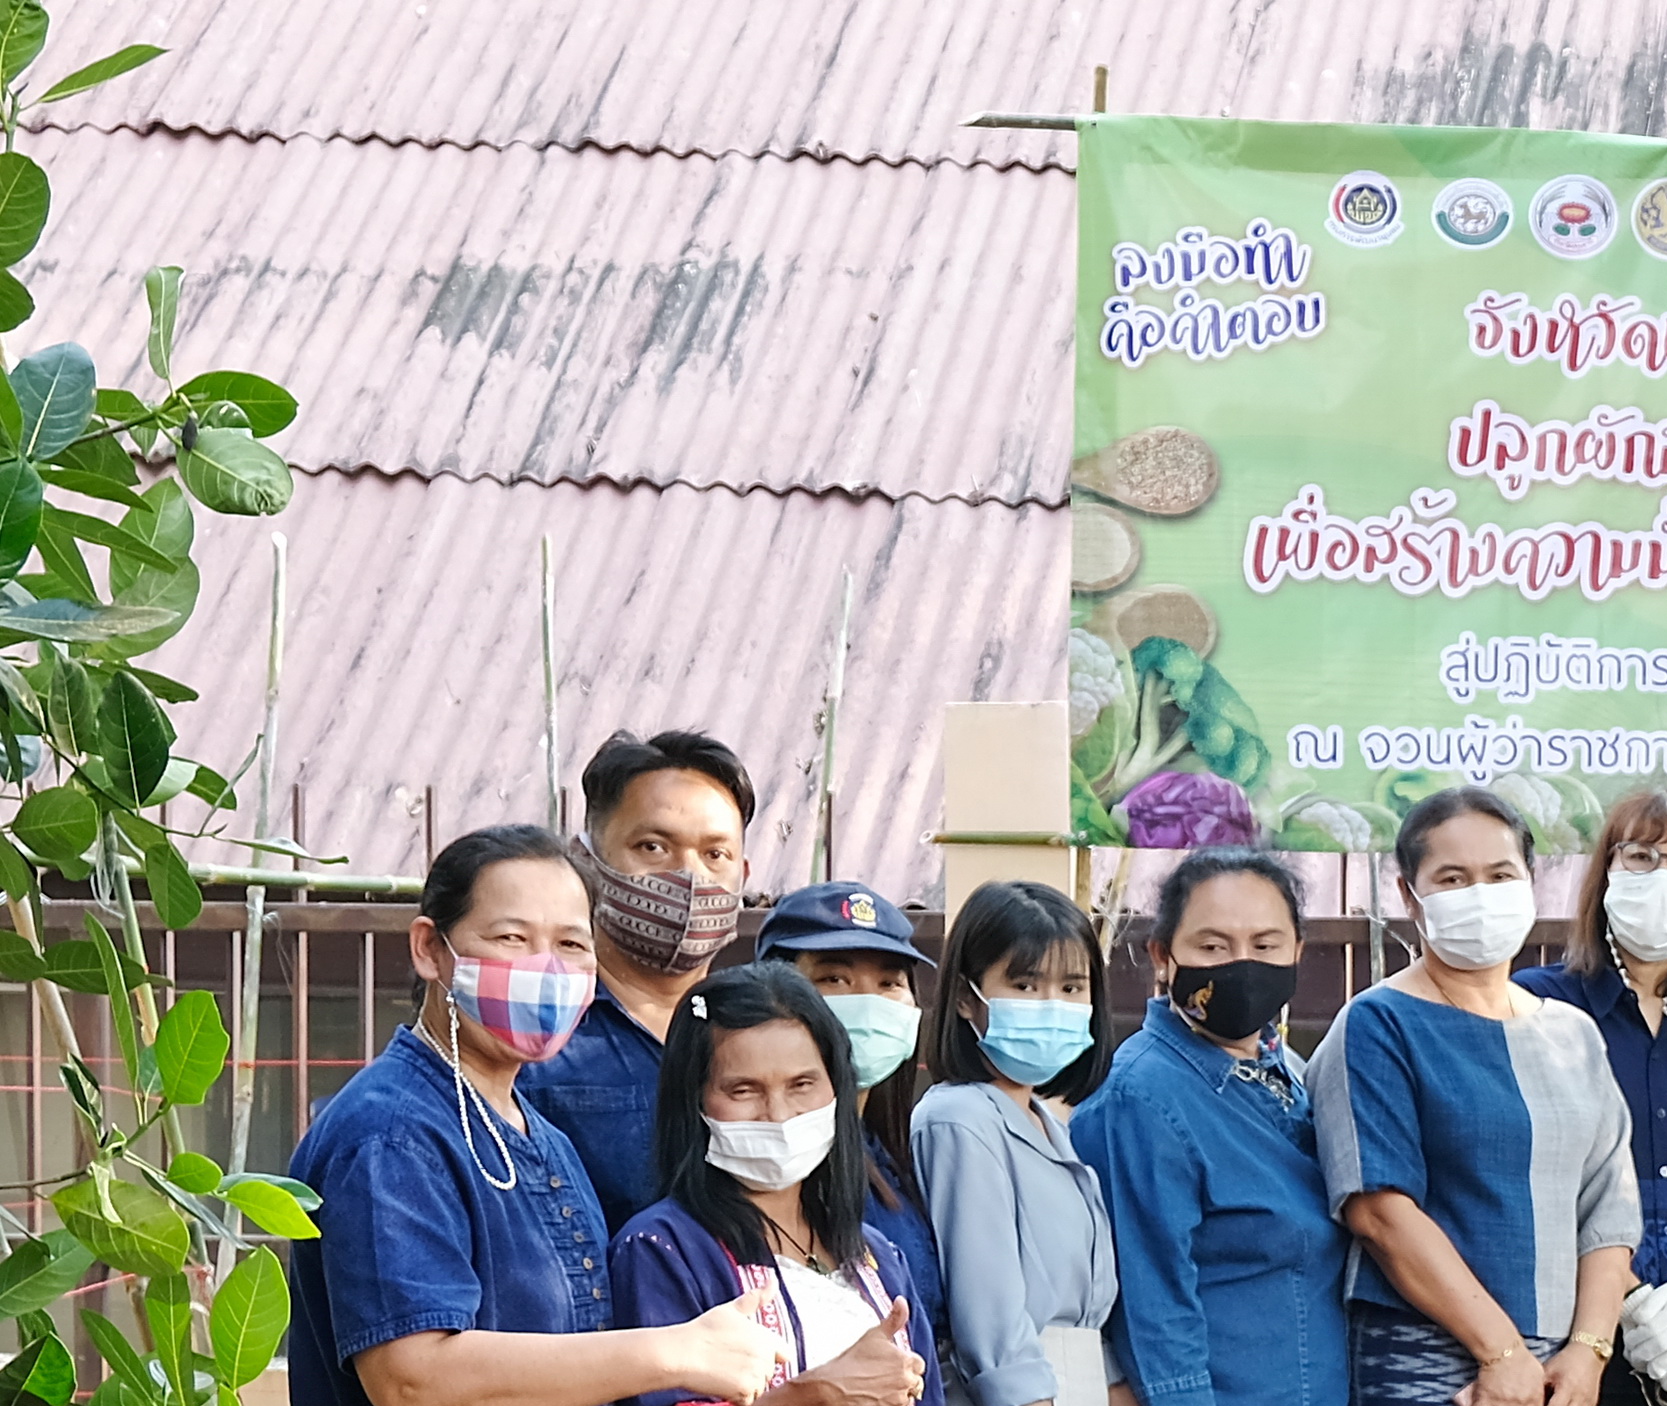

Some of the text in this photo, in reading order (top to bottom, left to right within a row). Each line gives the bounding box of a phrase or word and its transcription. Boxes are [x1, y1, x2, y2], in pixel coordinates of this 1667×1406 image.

[1114, 221, 1306, 288] ลงมือทำ
[1104, 293, 1322, 363] คือคำตอบ
[1292, 729, 1338, 764] ณ
[619, 913, 661, 937] GUCCI
